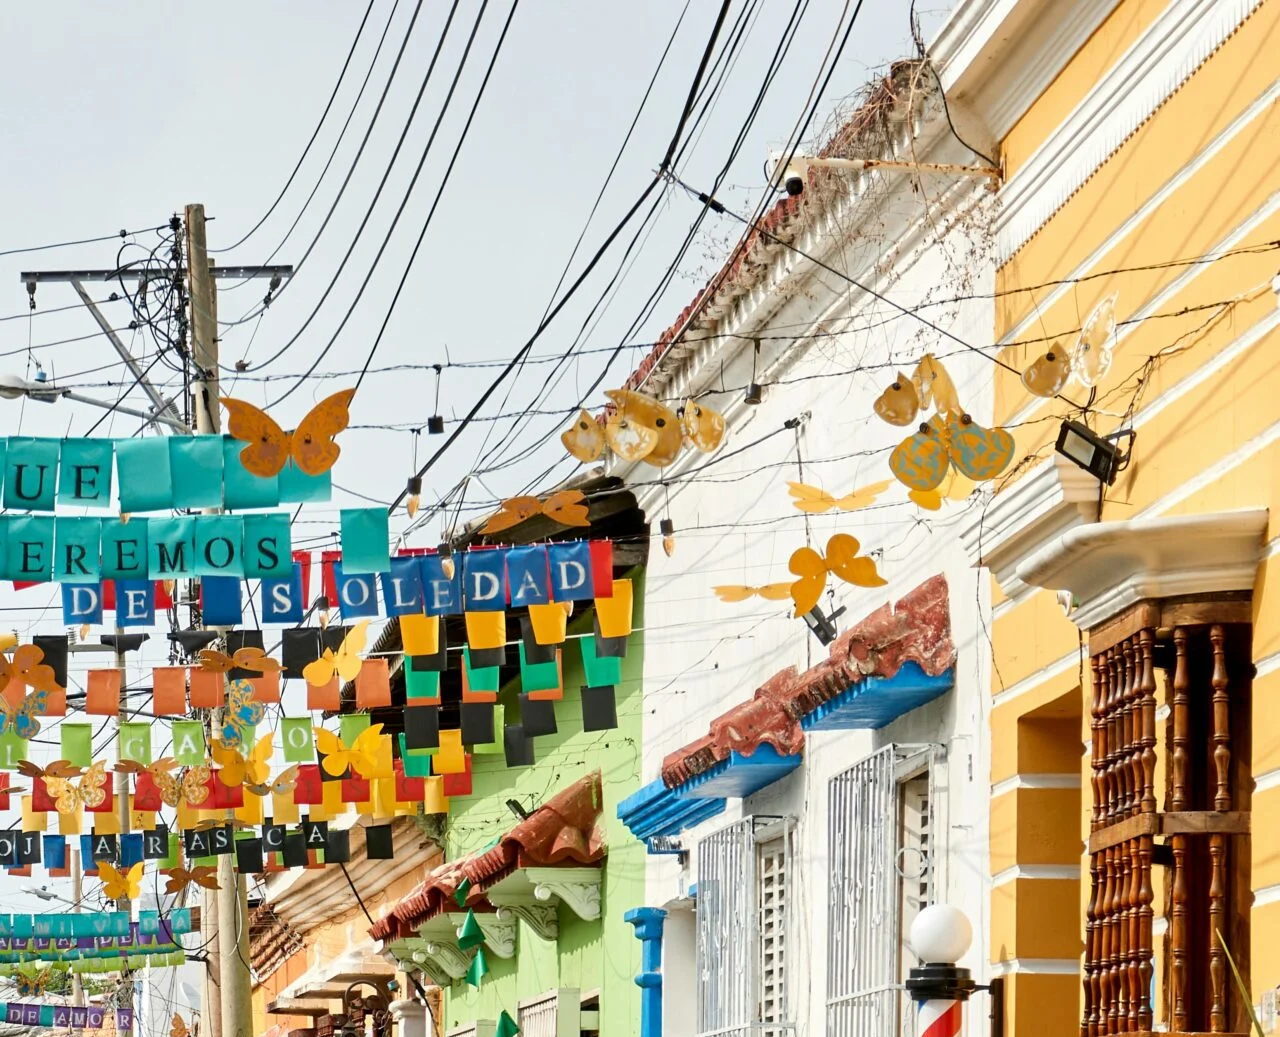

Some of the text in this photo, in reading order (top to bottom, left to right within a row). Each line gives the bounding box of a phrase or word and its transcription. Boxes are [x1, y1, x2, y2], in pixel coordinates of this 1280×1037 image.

[70, 587, 148, 619] DE
[271, 560, 587, 614] SOLEDAD
[94, 916, 187, 933] VIDA
[9, 1009, 40, 1022] DE
[55, 1013, 130, 1027] AMOR
